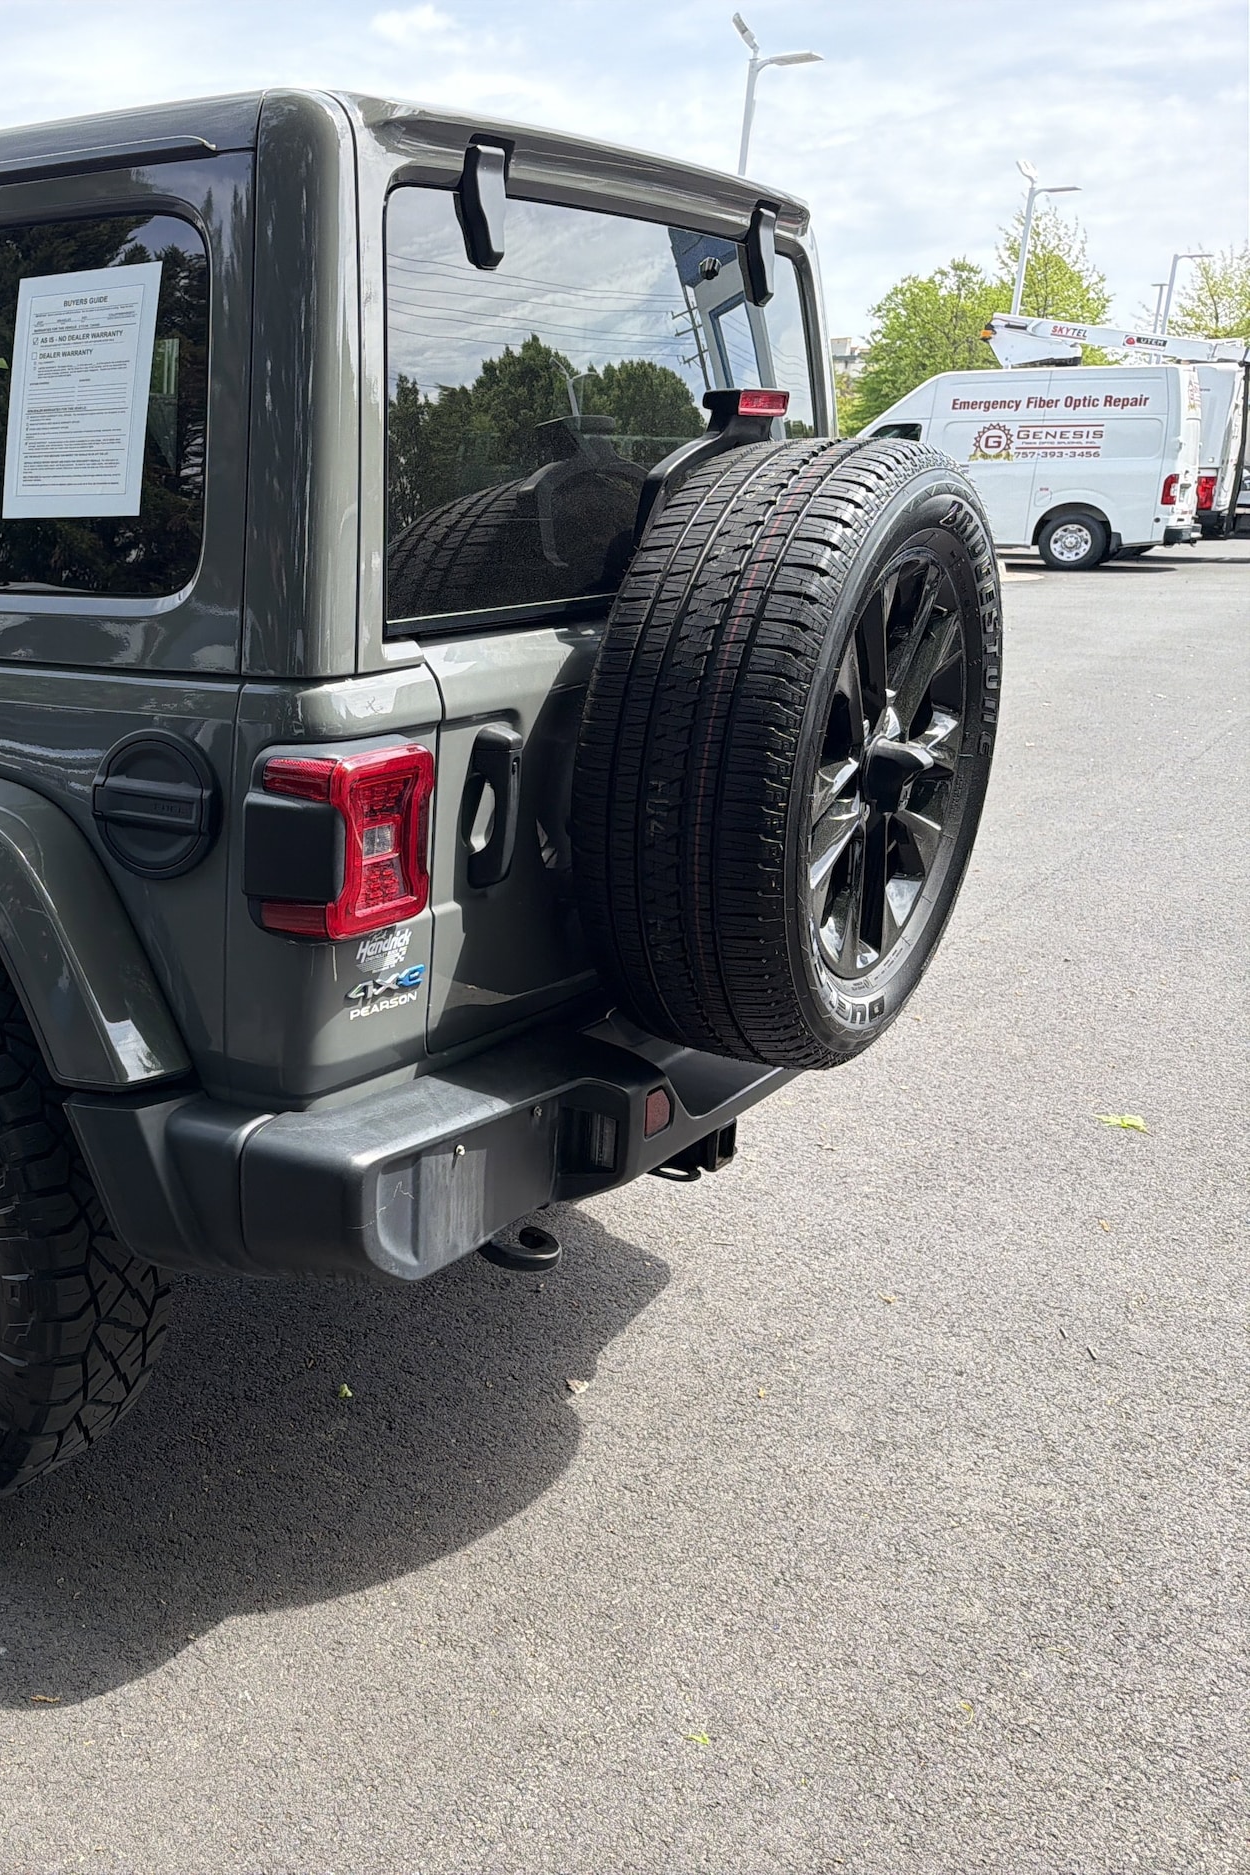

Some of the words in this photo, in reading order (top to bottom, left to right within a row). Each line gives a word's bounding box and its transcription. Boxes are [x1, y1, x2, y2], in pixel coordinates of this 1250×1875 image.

[63, 298, 88, 308] BUYERS
[89, 296, 108, 304] GUIDE
[67, 333, 91, 341] DEALER
[91, 330, 124, 339] WARRANTY
[1051, 325, 1088, 338] SKYTEL
[38, 352, 61, 360] DEALER
[61, 349, 94, 357] WARRANTY
[951, 398, 1022, 412] Emergency
[1026, 396, 1060, 409] Fiber
[1064, 395, 1100, 409] Optic
[1103, 394, 1150, 409] Repair
[984, 435, 1002, 449] G
[1014, 451, 1101, 459] 757-393-3456
[355, 928, 412, 963] Hendrick
[350, 991, 417, 1020] PEARSON
